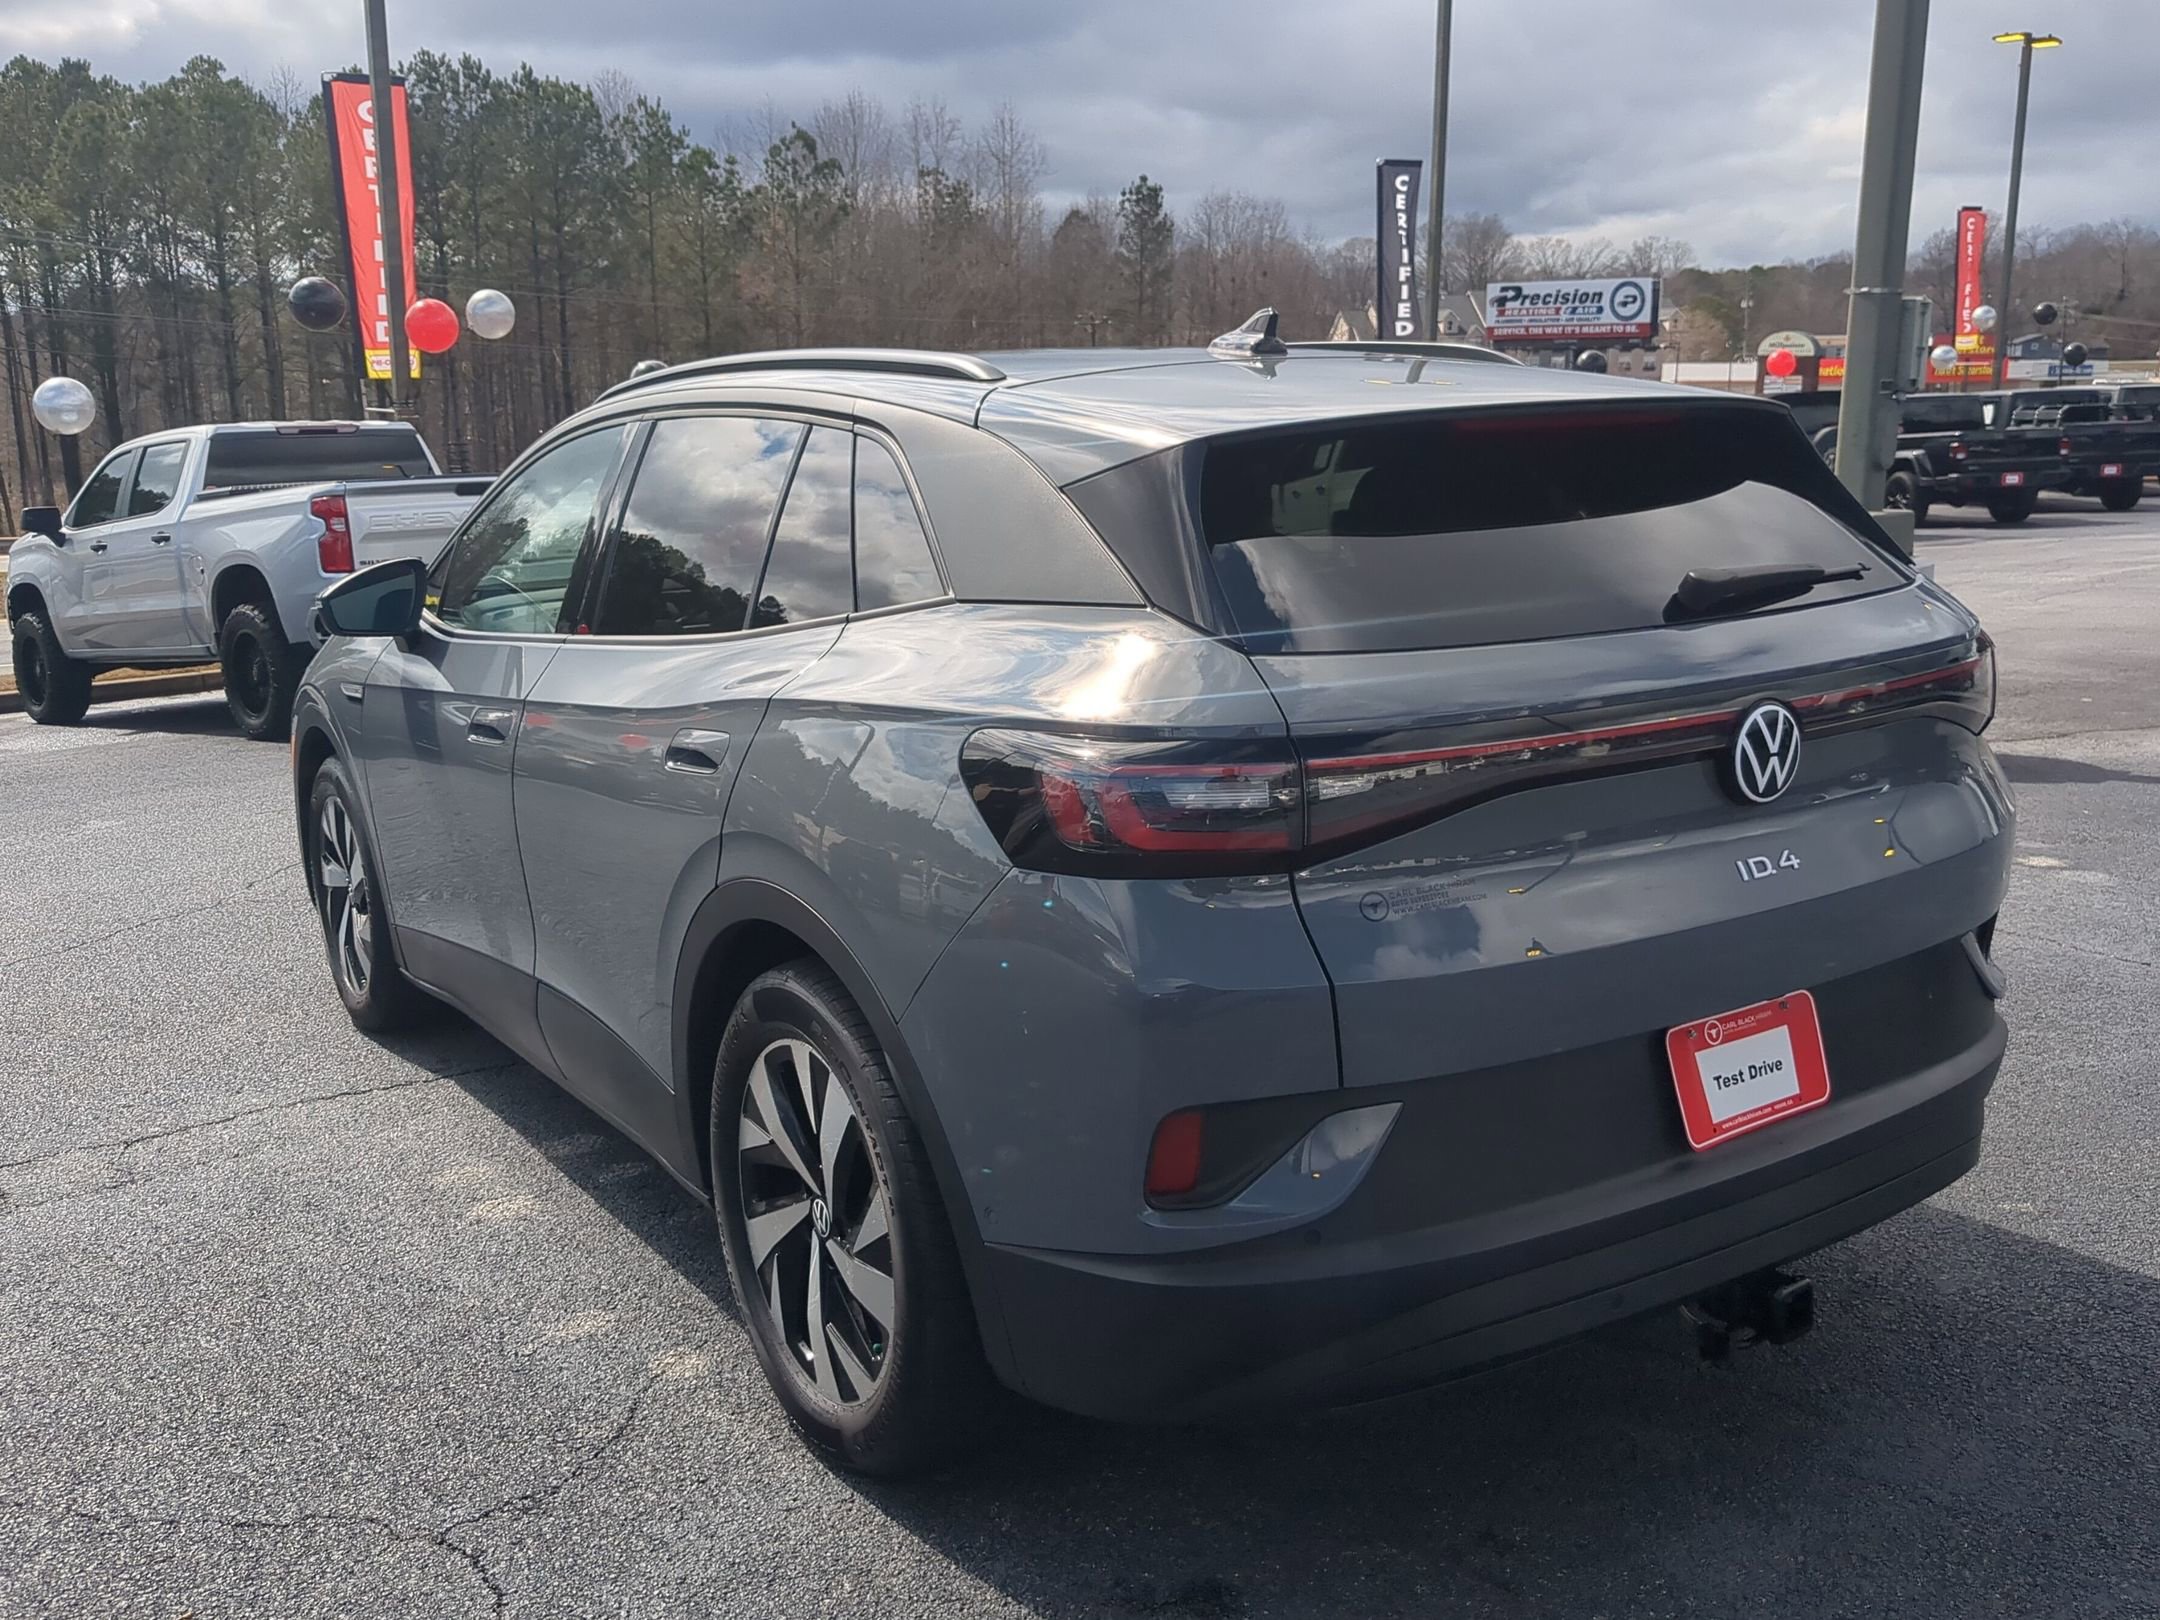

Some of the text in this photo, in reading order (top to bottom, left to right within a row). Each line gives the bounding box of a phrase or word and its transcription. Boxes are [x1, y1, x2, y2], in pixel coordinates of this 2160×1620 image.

[1395, 175, 1415, 337] CERTIFIED
[1489, 286, 1604, 308] Precision
[1504, 308, 1557, 317] HEATING
[1575, 306, 1598, 315] AIR
[1544, 326, 1563, 334] WAY
[1564, 326, 1581, 334] IT'S
[1581, 325, 1612, 334] MEANT
[1612, 324, 1624, 333] TO
[1736, 849, 1801, 882] ID.4
[1738, 1015, 1755, 1026] BLACK
[1713, 1058, 1783, 1090] Test Drive
